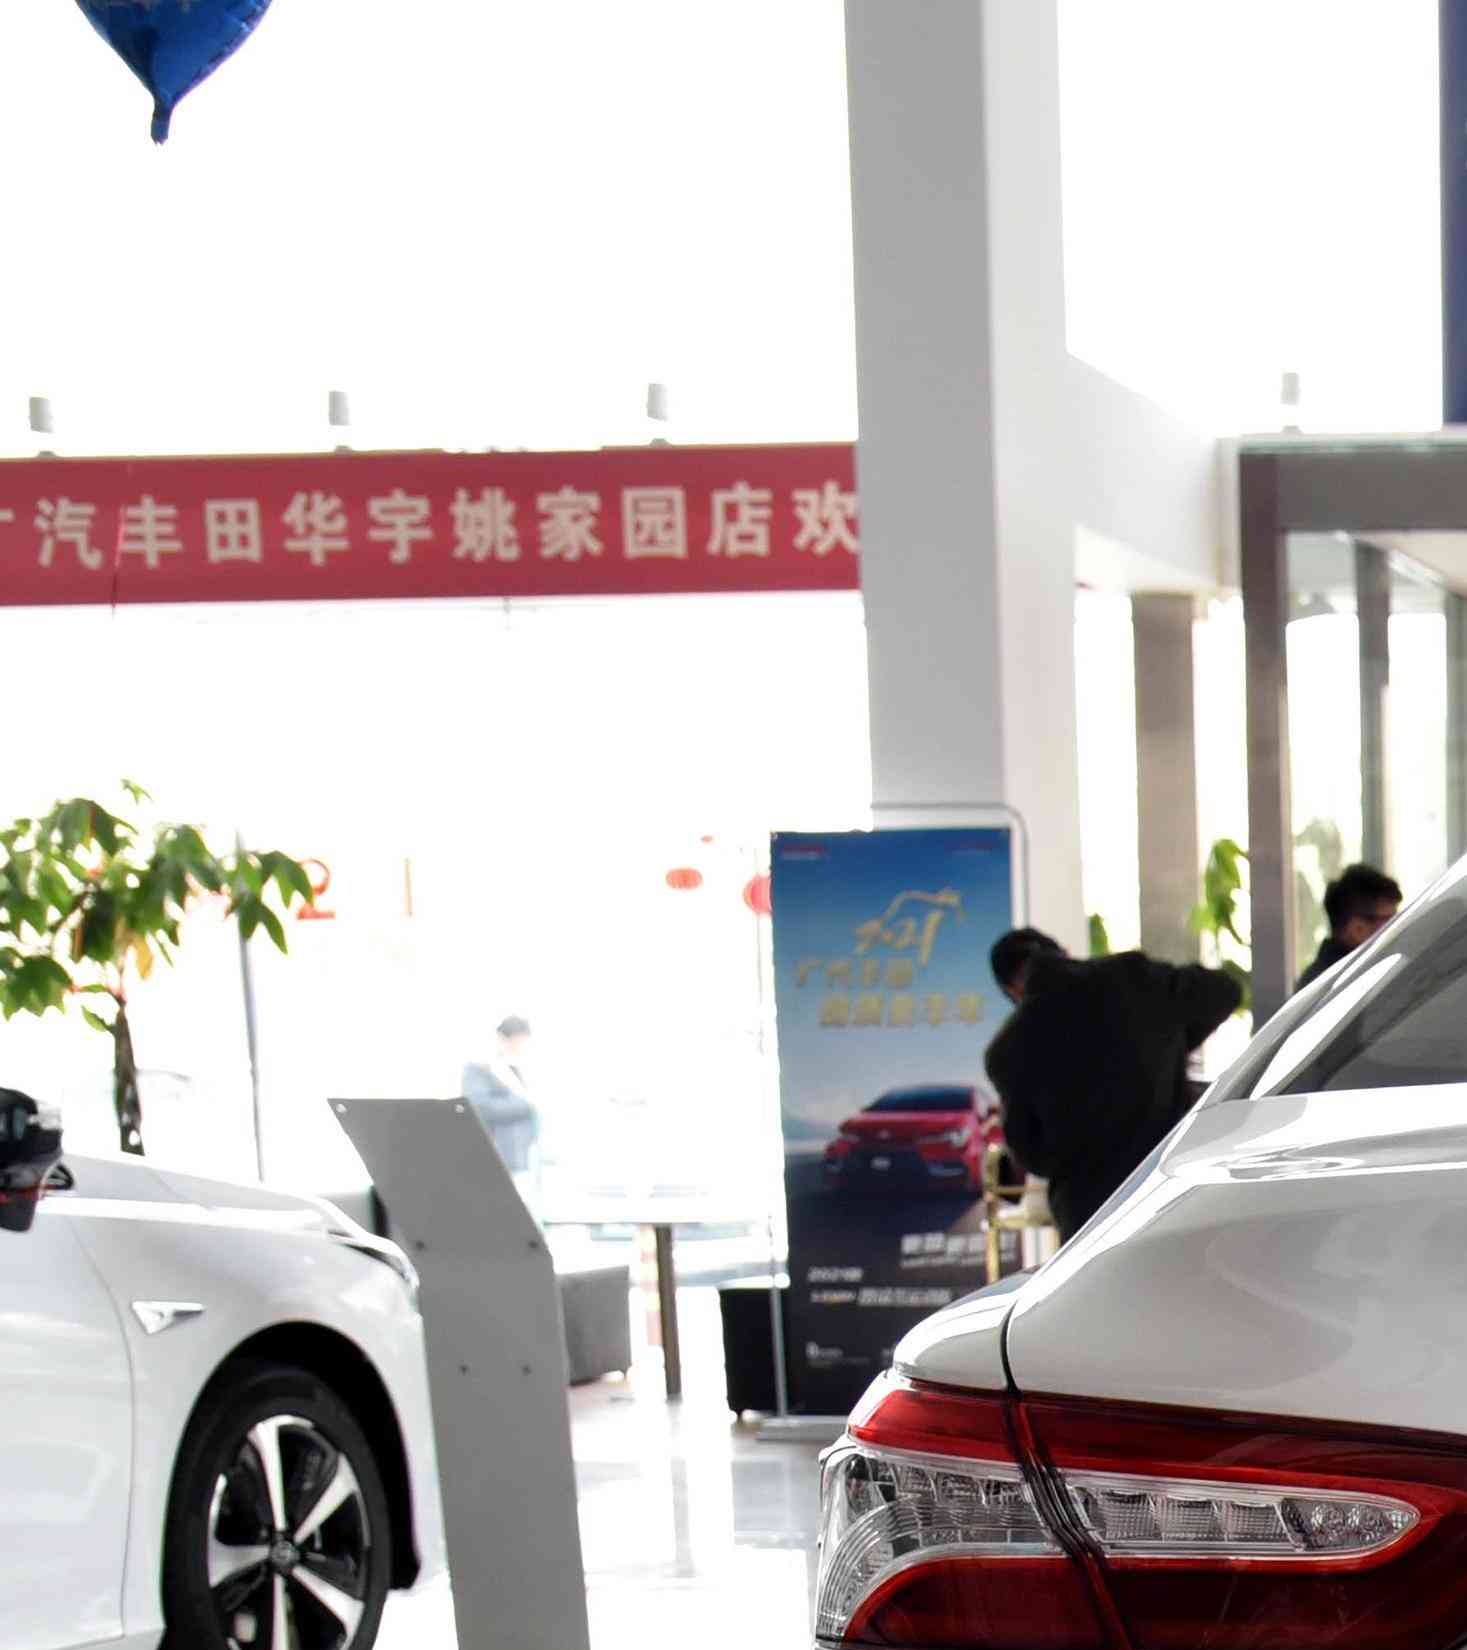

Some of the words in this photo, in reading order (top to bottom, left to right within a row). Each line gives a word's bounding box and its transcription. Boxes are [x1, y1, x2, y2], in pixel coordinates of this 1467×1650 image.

[0, 482, 859, 570] 汽丰田华宇姚家园店欢
